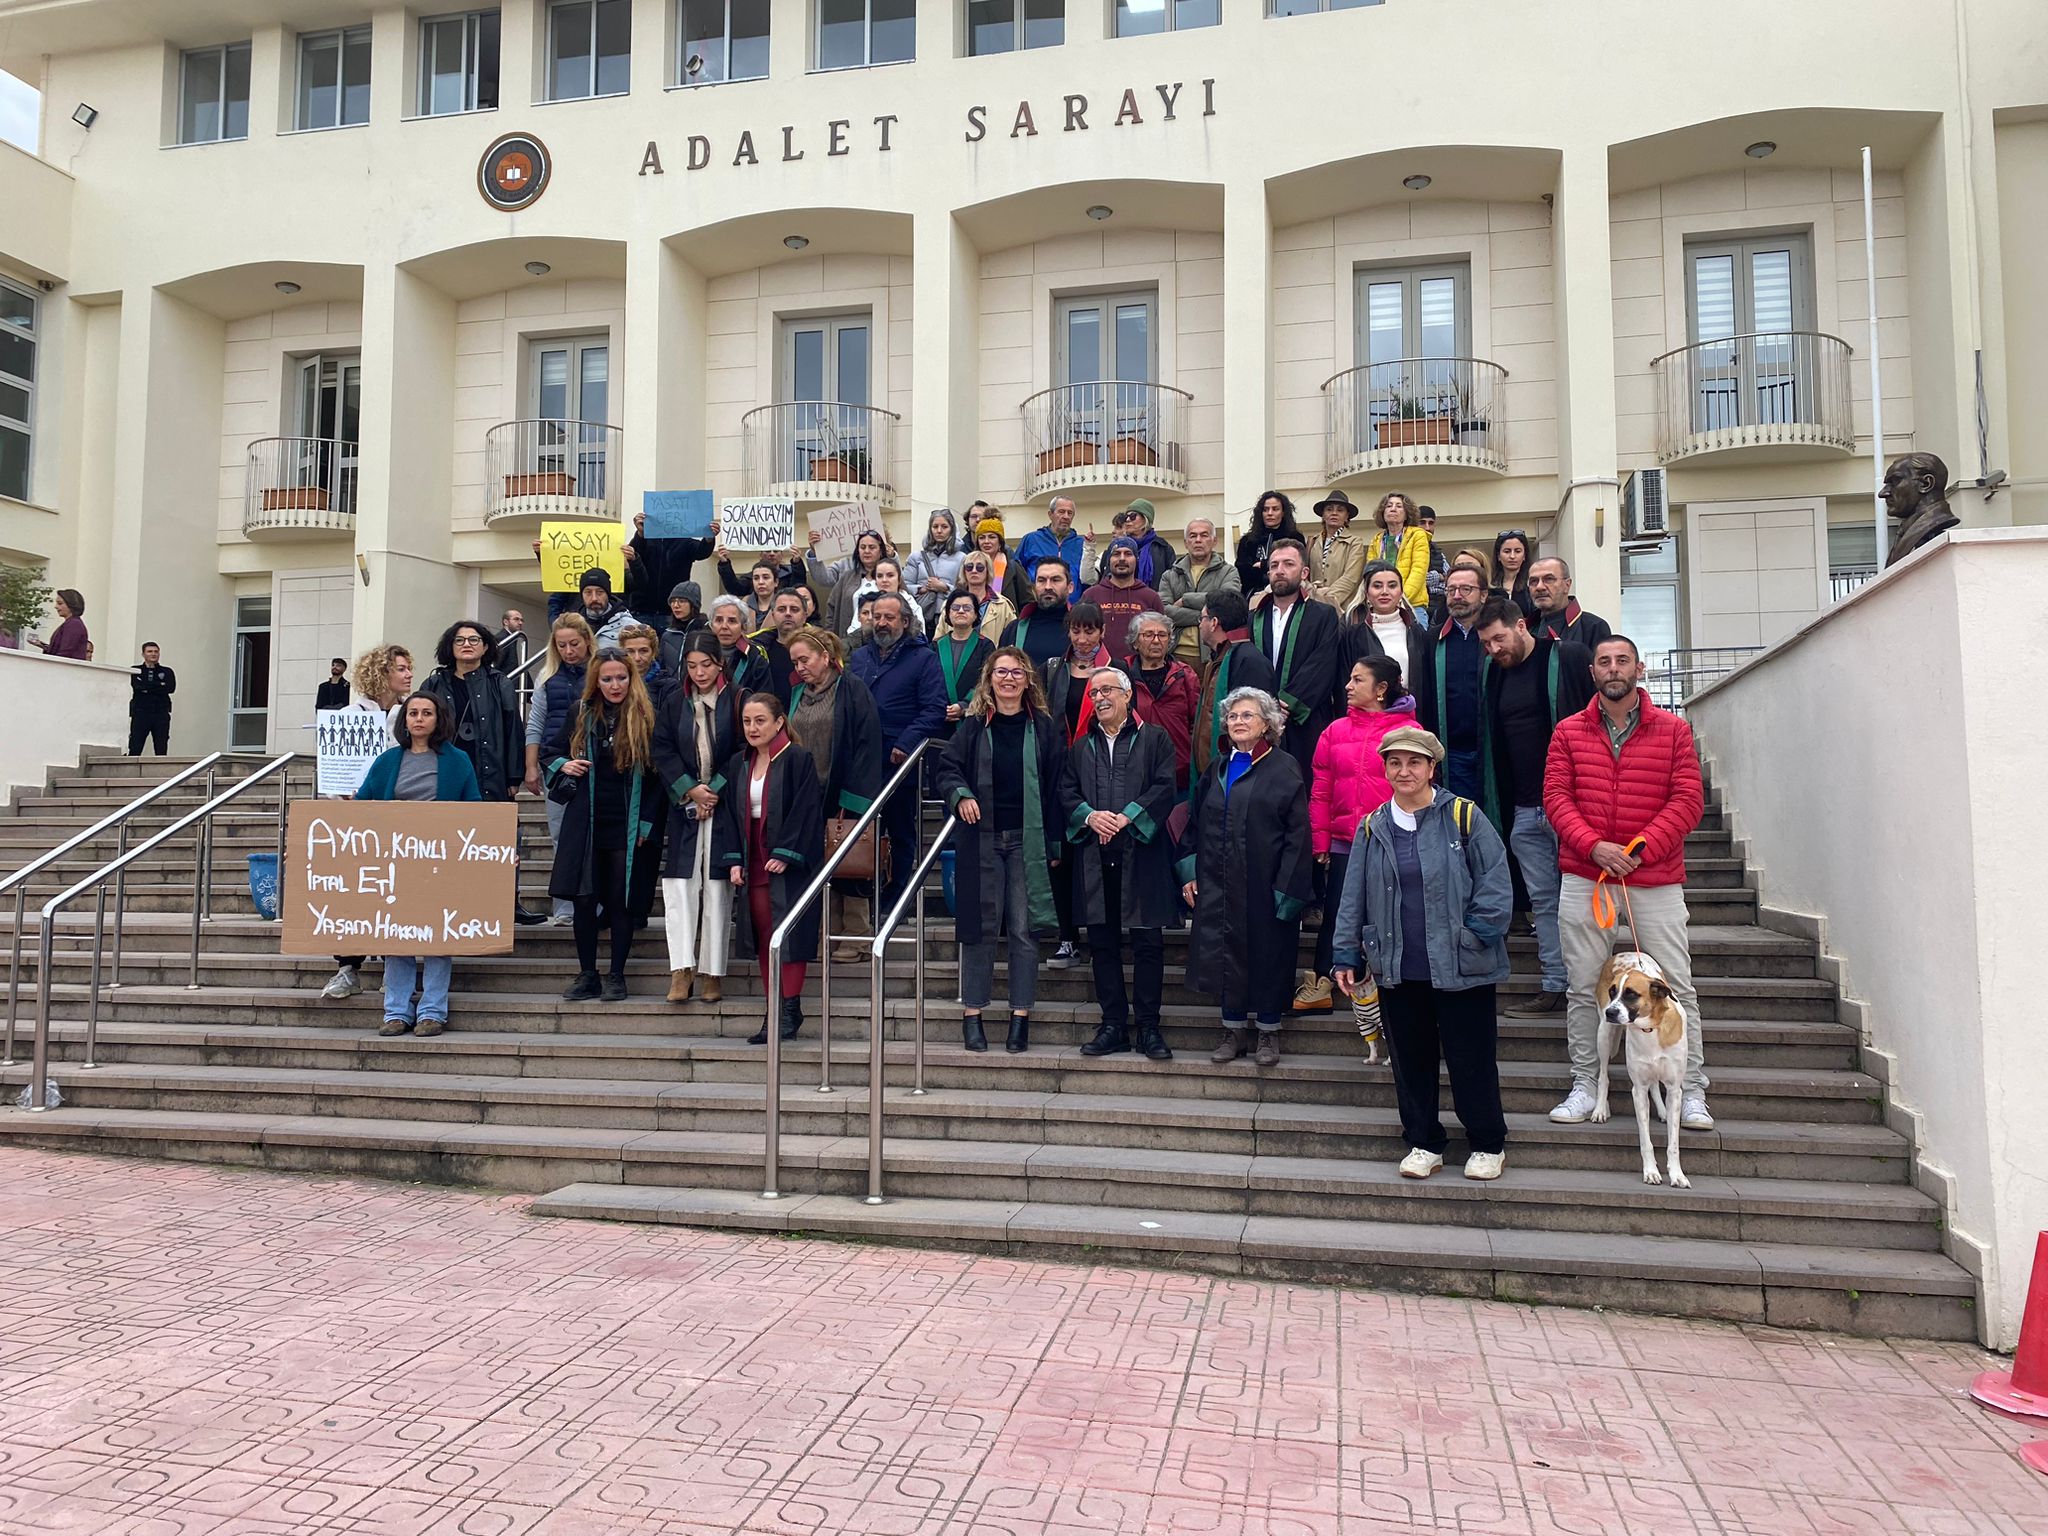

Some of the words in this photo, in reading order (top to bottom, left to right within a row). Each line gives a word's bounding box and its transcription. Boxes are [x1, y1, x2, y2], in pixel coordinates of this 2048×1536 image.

[638, 114, 898, 176] ADALET
[965, 78, 1216, 143] SARAYI
[723, 503, 793, 523] SOKAKTAYIM
[547, 531, 610, 551] YASAYI
[722, 526, 793, 546] YANINDAYIM
[820, 523, 846, 540] ASAYI
[558, 552, 600, 570] GERİ
[563, 572, 583, 588] ÇE
[330, 714, 375, 726] ONLARA
[391, 831, 447, 860] KANLI
[456, 827, 515, 865] YASAYI
[357, 862, 397, 904] ET!
[307, 901, 373, 941] YAŞAM
[443, 908, 500, 942] KORU
